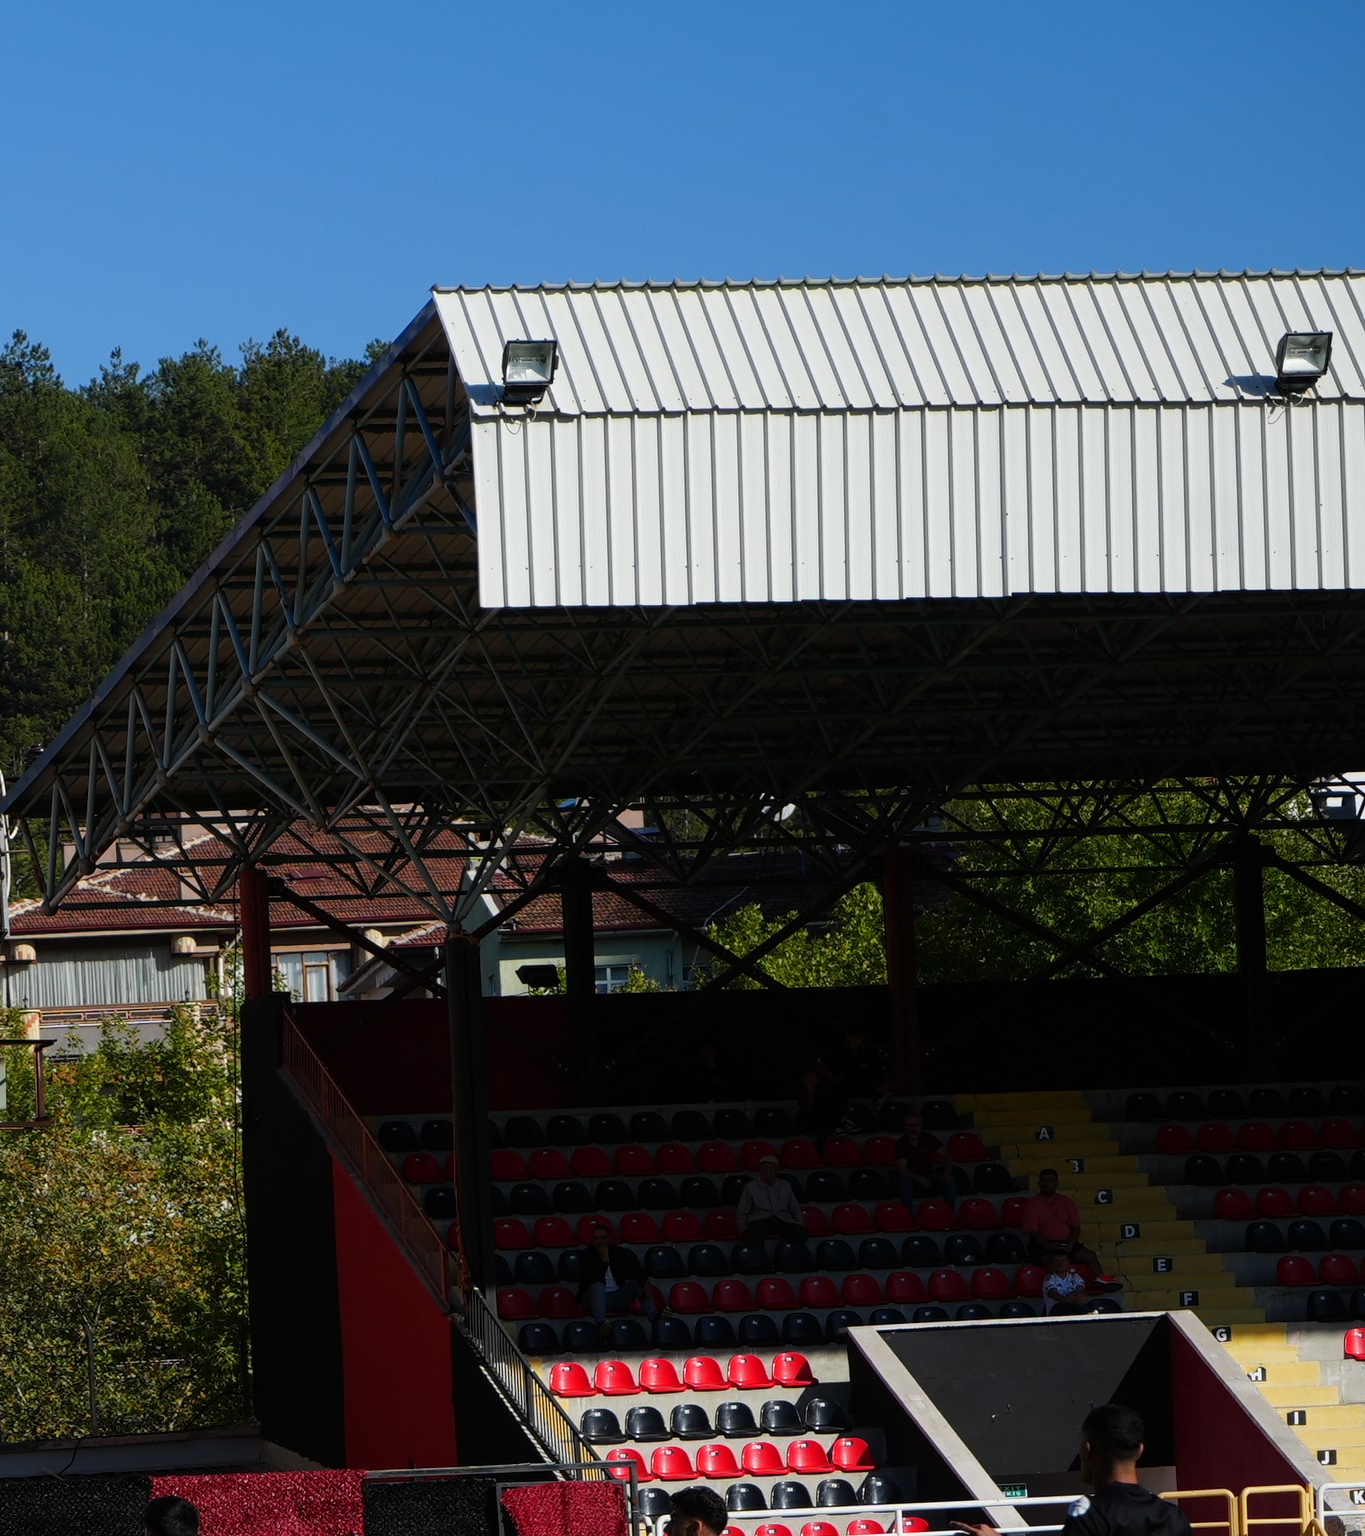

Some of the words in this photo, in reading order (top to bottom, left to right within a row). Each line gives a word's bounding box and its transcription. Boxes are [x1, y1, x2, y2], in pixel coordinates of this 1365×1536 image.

[1098, 1191, 1108, 1203] C
[1125, 1225, 1135, 1237] D
[1157, 1259, 1166, 1271] E
[1184, 1293, 1194, 1305] F
[1216, 1328, 1227, 1341] G
[1321, 1450, 1330, 1465] J
[1354, 1490, 1365, 1504] K
